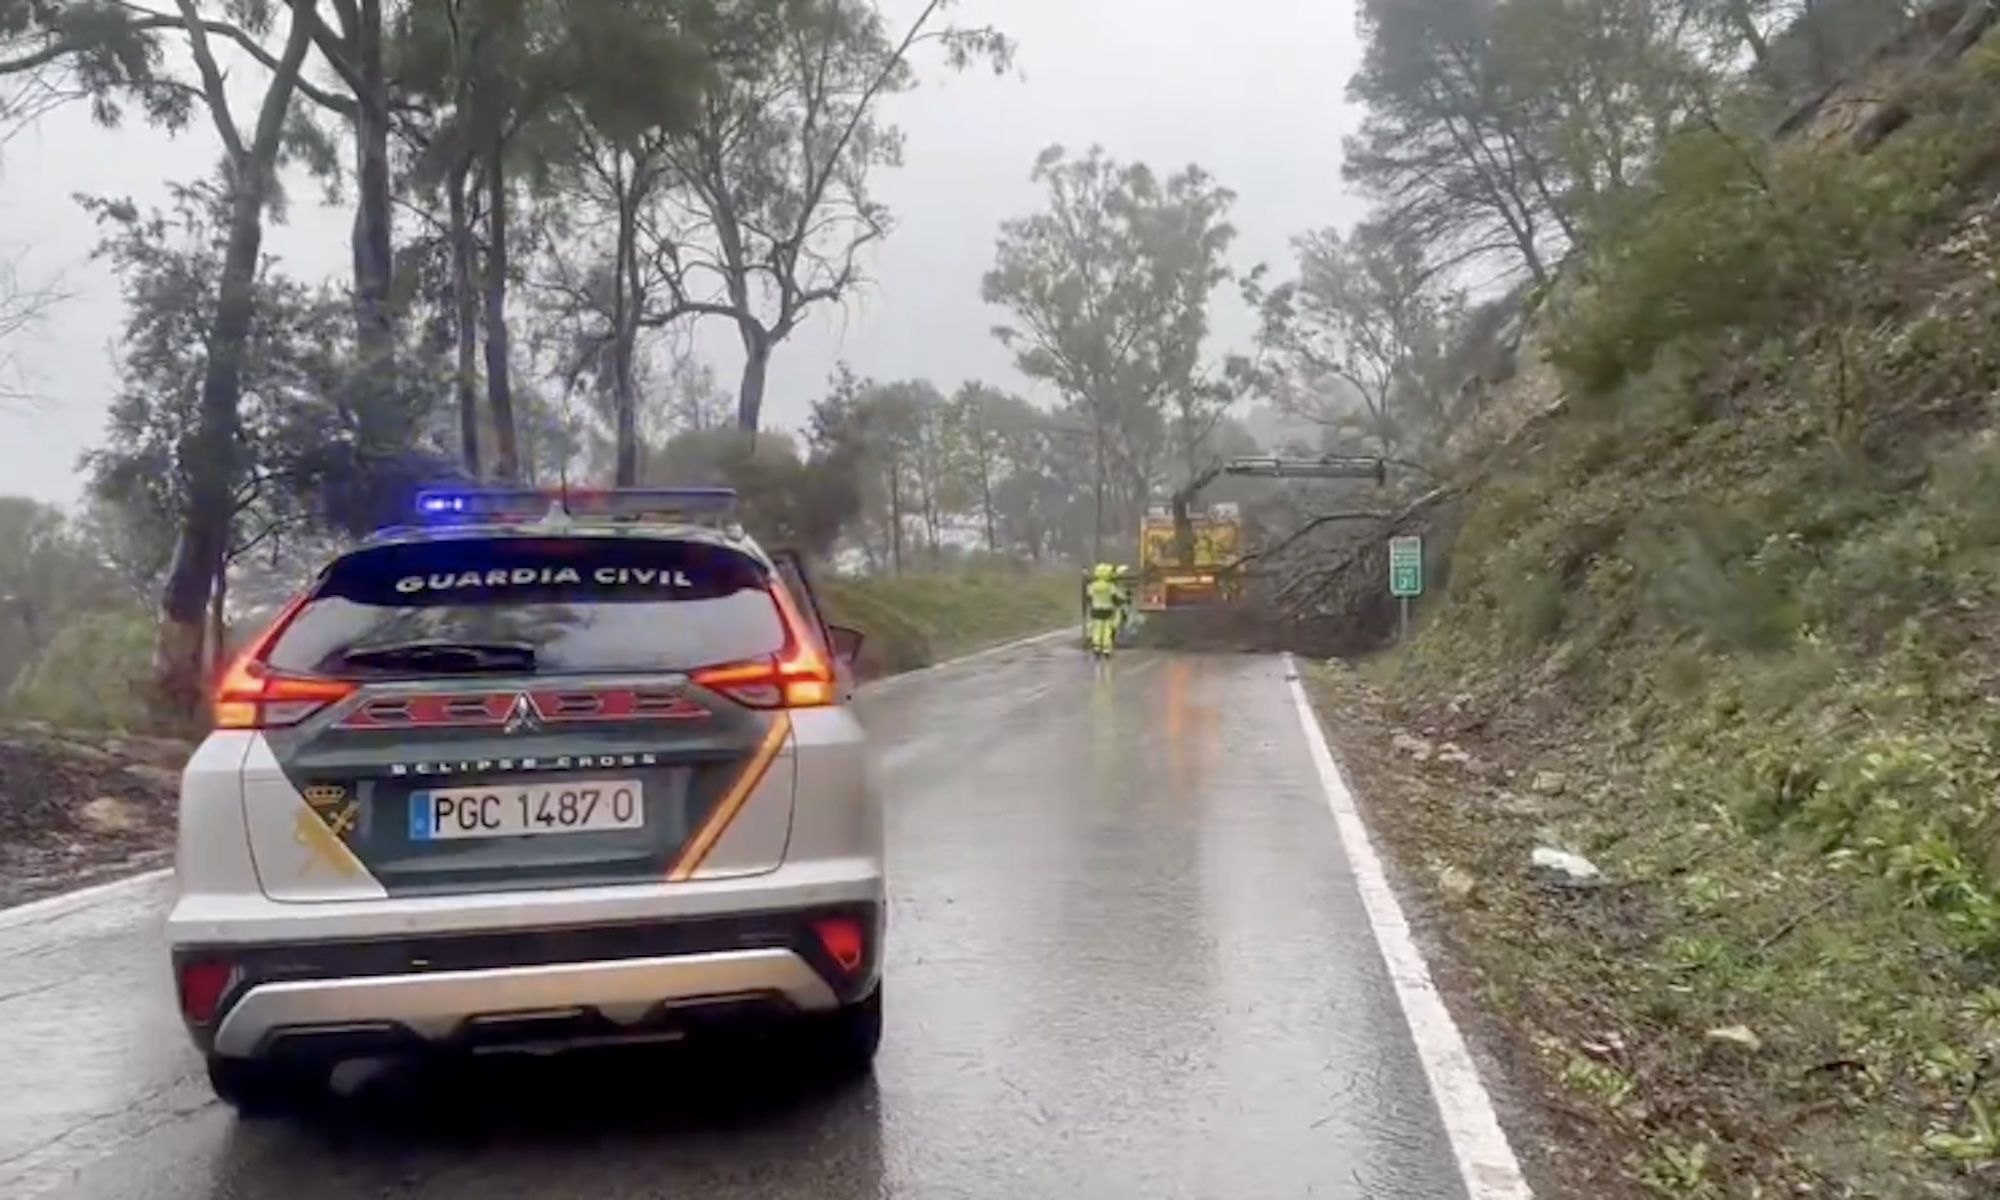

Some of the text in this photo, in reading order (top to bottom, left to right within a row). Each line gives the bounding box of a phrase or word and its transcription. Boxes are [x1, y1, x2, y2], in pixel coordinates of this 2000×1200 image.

[396, 567, 693, 593] GUARDIA CIVIL
[392, 753, 657, 775] ECLIPSE CROSS
[434, 796, 501, 832] PGC
[518, 789, 601, 827] 1487
